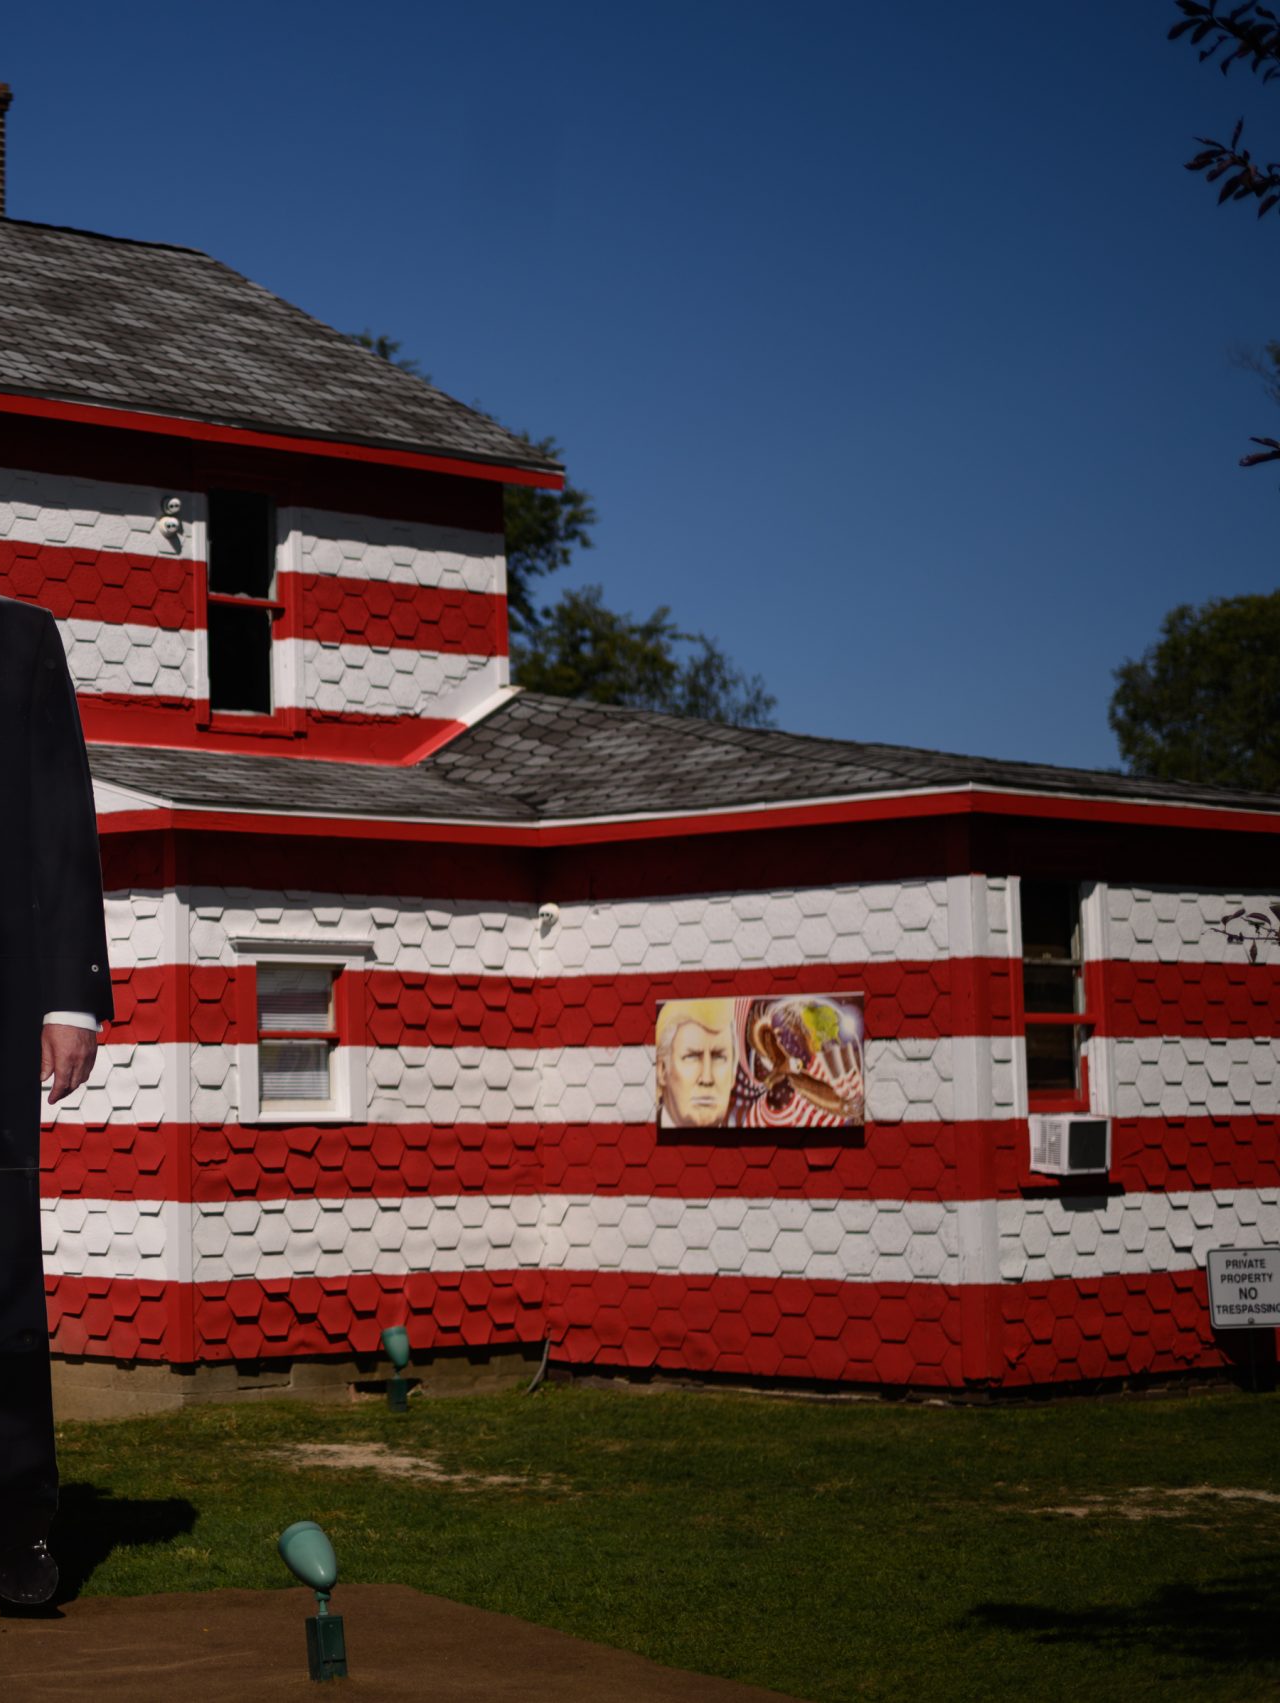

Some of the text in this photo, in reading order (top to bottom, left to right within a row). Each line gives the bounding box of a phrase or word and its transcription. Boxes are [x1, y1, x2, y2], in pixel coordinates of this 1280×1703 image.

[1226, 1259, 1266, 1269] PRIVATE
[1220, 1272, 1273, 1283] PROPERTY
[1238, 1287, 1258, 1300] NO
